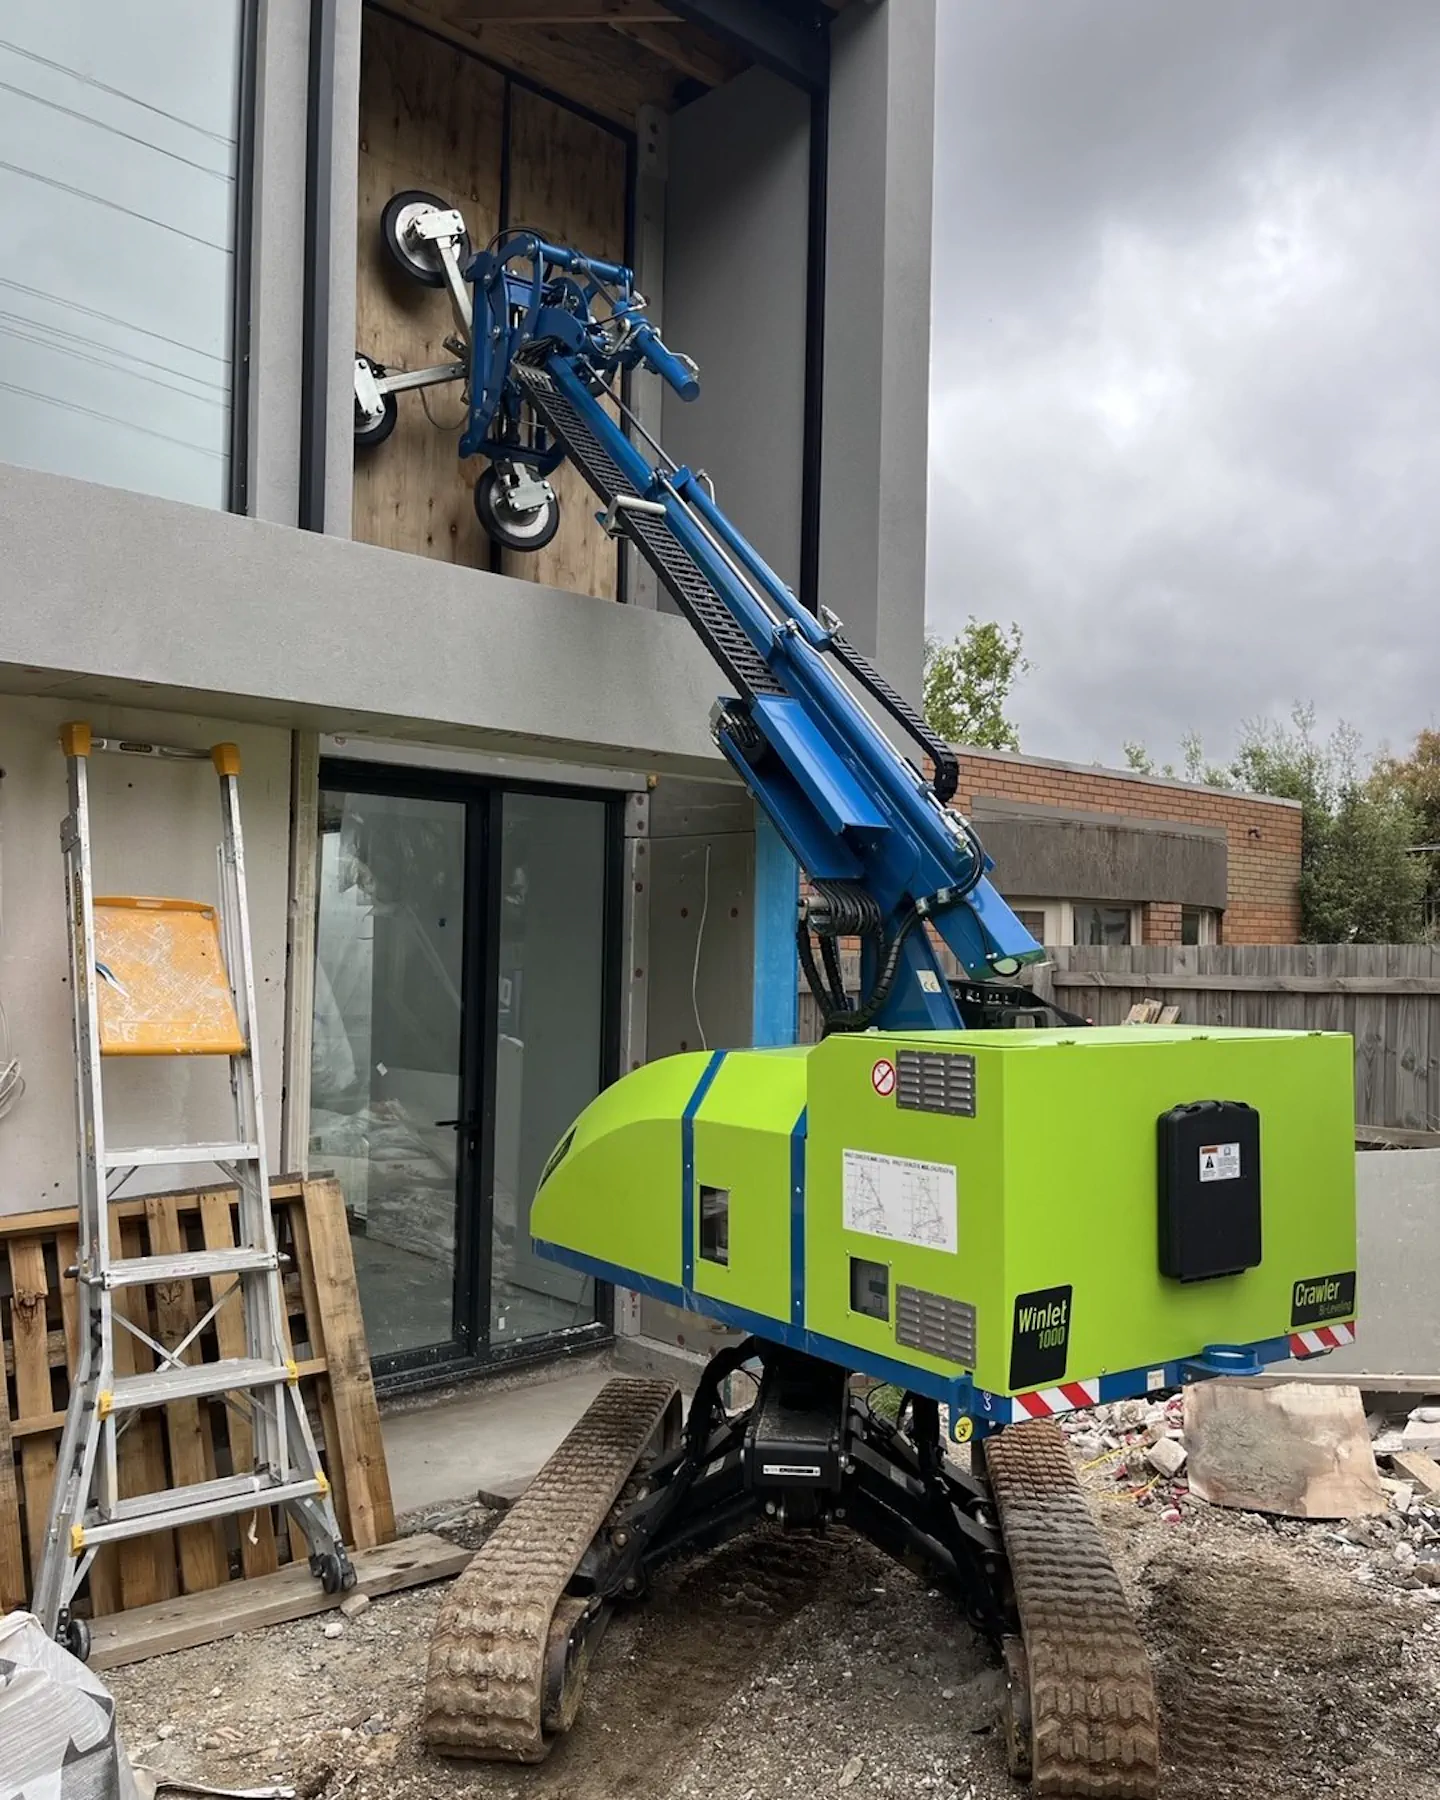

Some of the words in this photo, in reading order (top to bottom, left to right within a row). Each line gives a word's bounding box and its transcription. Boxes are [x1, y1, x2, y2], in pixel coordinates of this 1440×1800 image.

[1295, 1278, 1341, 1307] Crawler
[1018, 1299, 1068, 1334] Winlet
[1038, 1326, 1066, 1350] 1000
